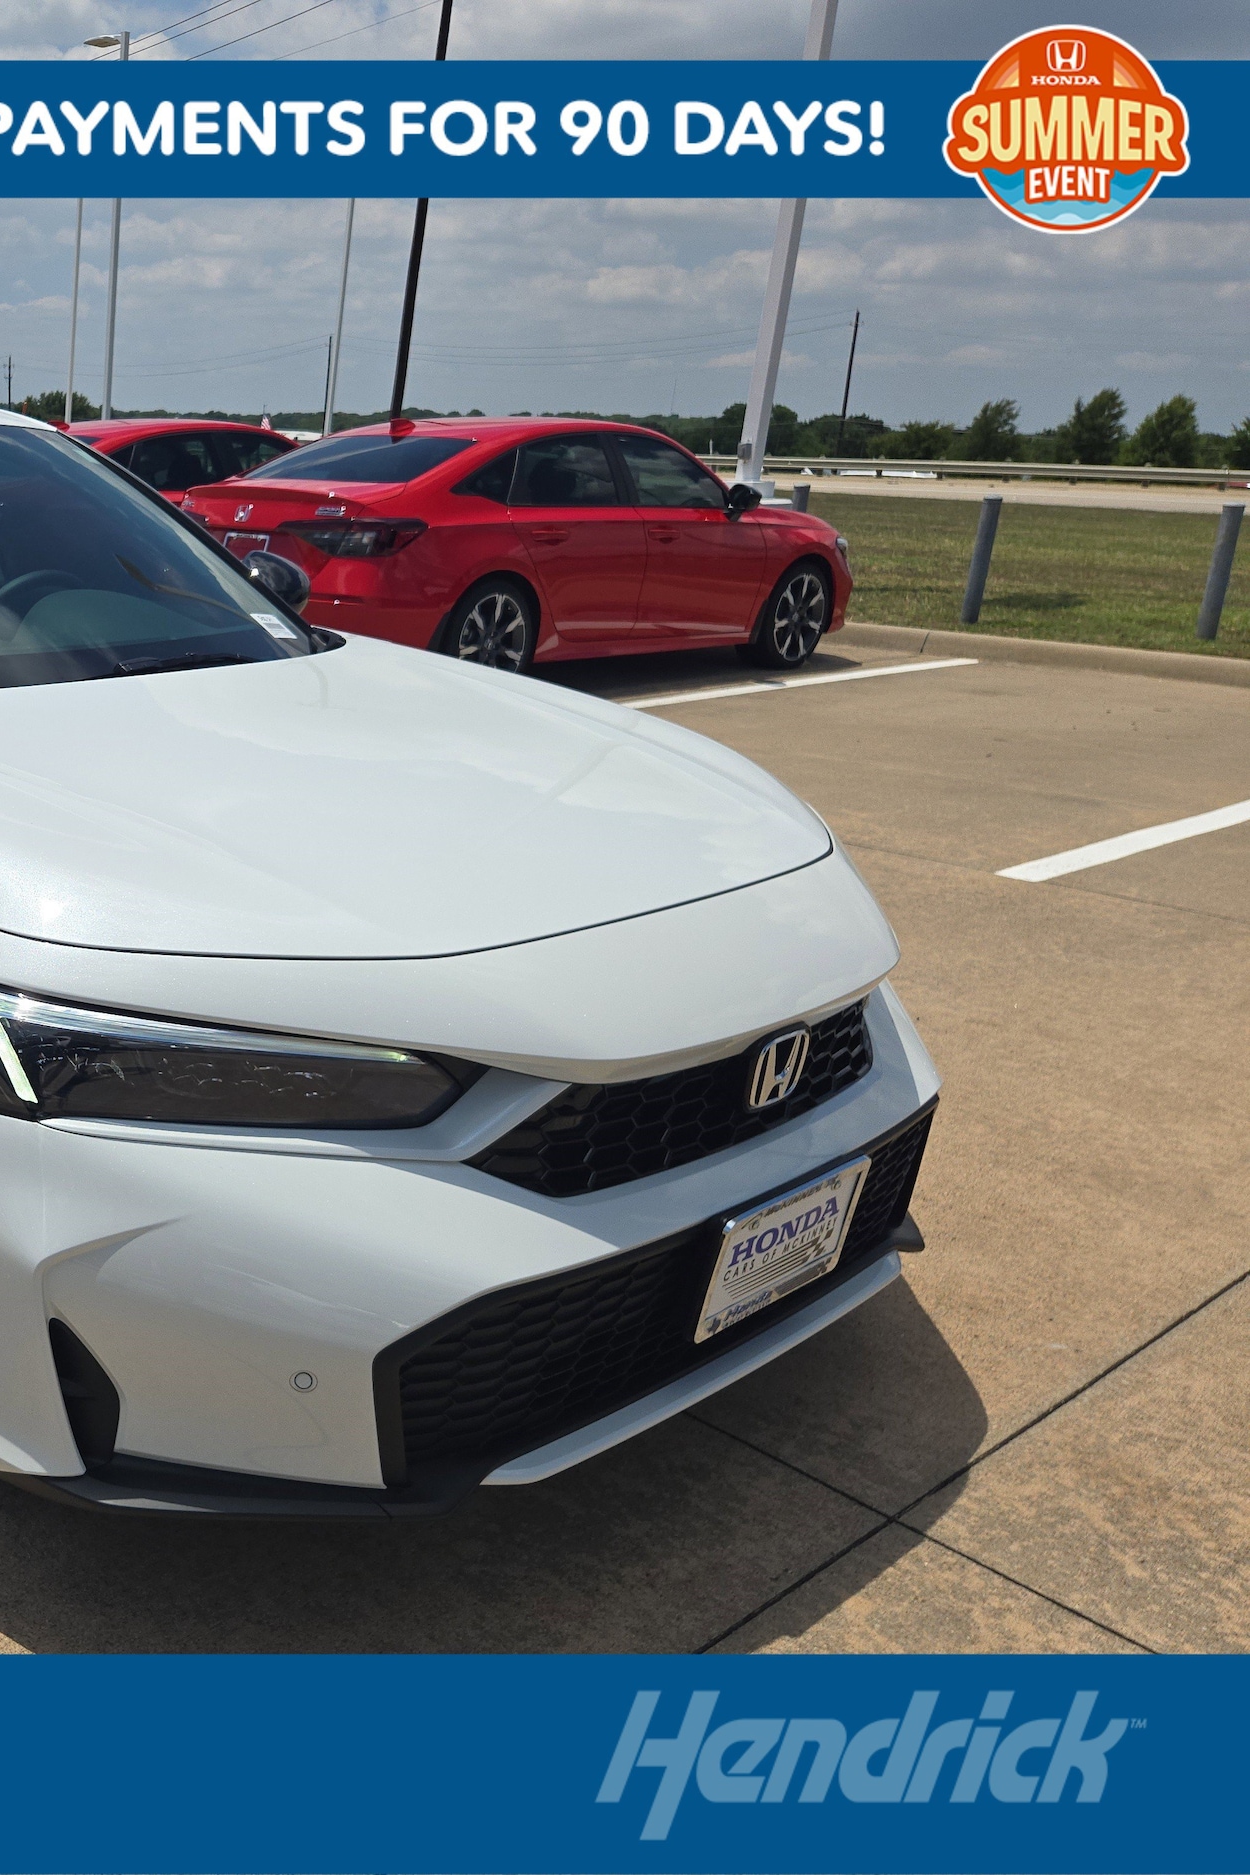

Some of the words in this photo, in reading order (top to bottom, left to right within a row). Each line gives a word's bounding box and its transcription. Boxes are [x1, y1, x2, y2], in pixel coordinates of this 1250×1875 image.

[727, 1196, 840, 1268] HONDA
[724, 1259, 756, 1281] CARS
[762, 1248, 778, 1264] OF
